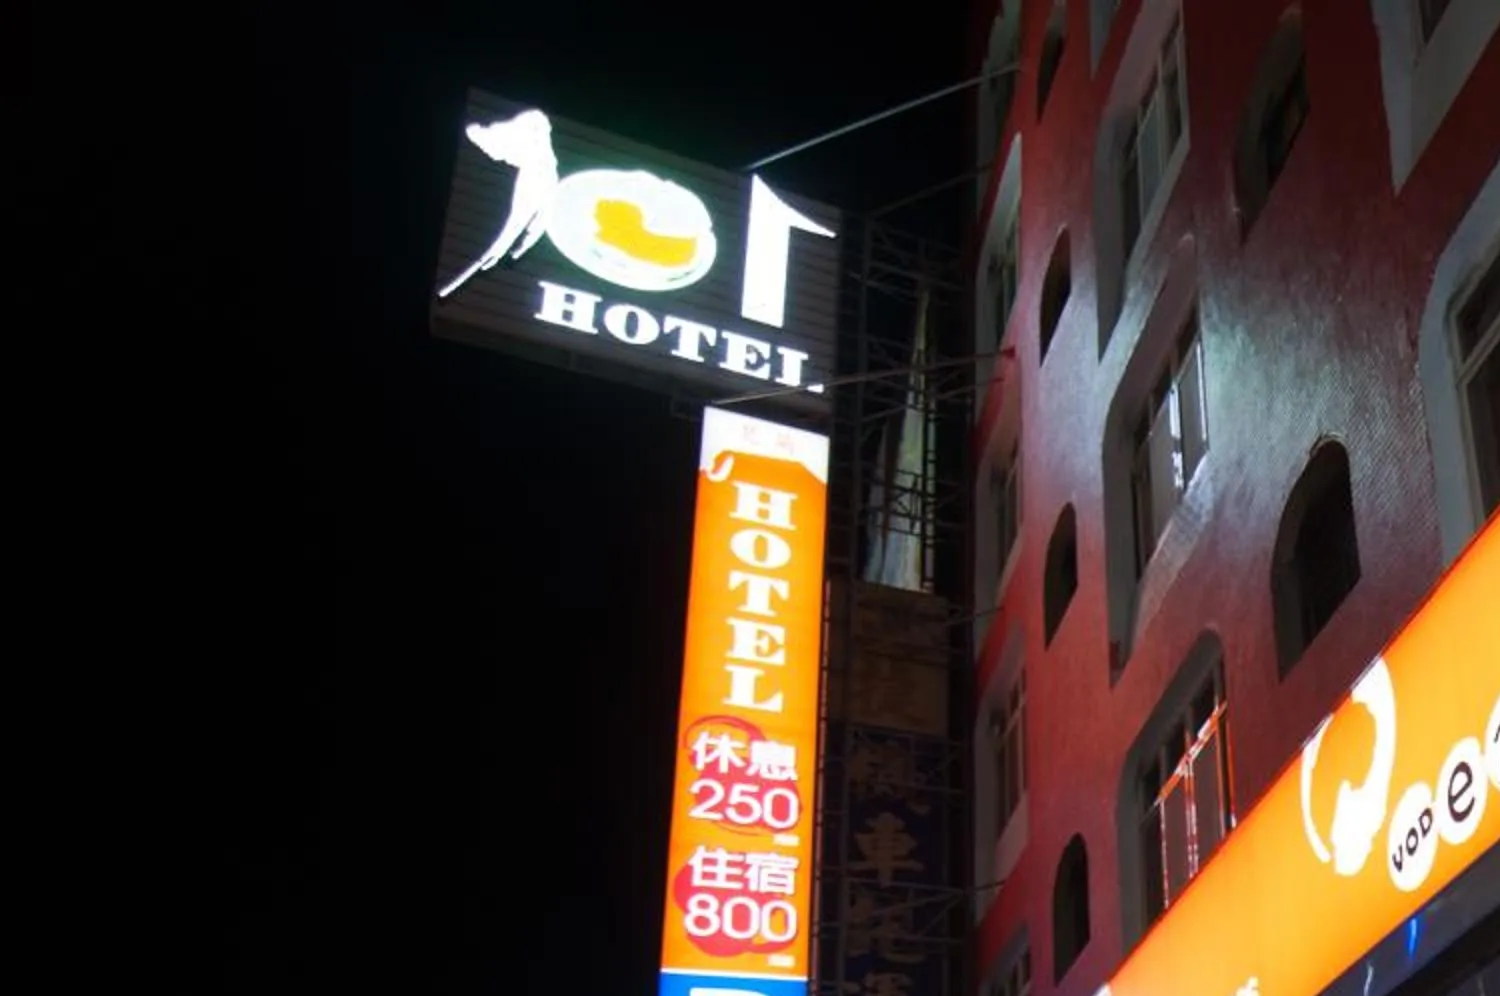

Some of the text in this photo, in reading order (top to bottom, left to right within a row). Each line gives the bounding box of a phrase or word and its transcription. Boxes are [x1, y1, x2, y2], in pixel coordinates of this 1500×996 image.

[533, 280, 825, 394] HOTEL
[722, 479, 799, 713] HOTEL
[692, 731, 800, 782] 休息
[688, 779, 800, 831] 250
[688, 846, 800, 896] 住宿
[683, 894, 798, 943] 800
